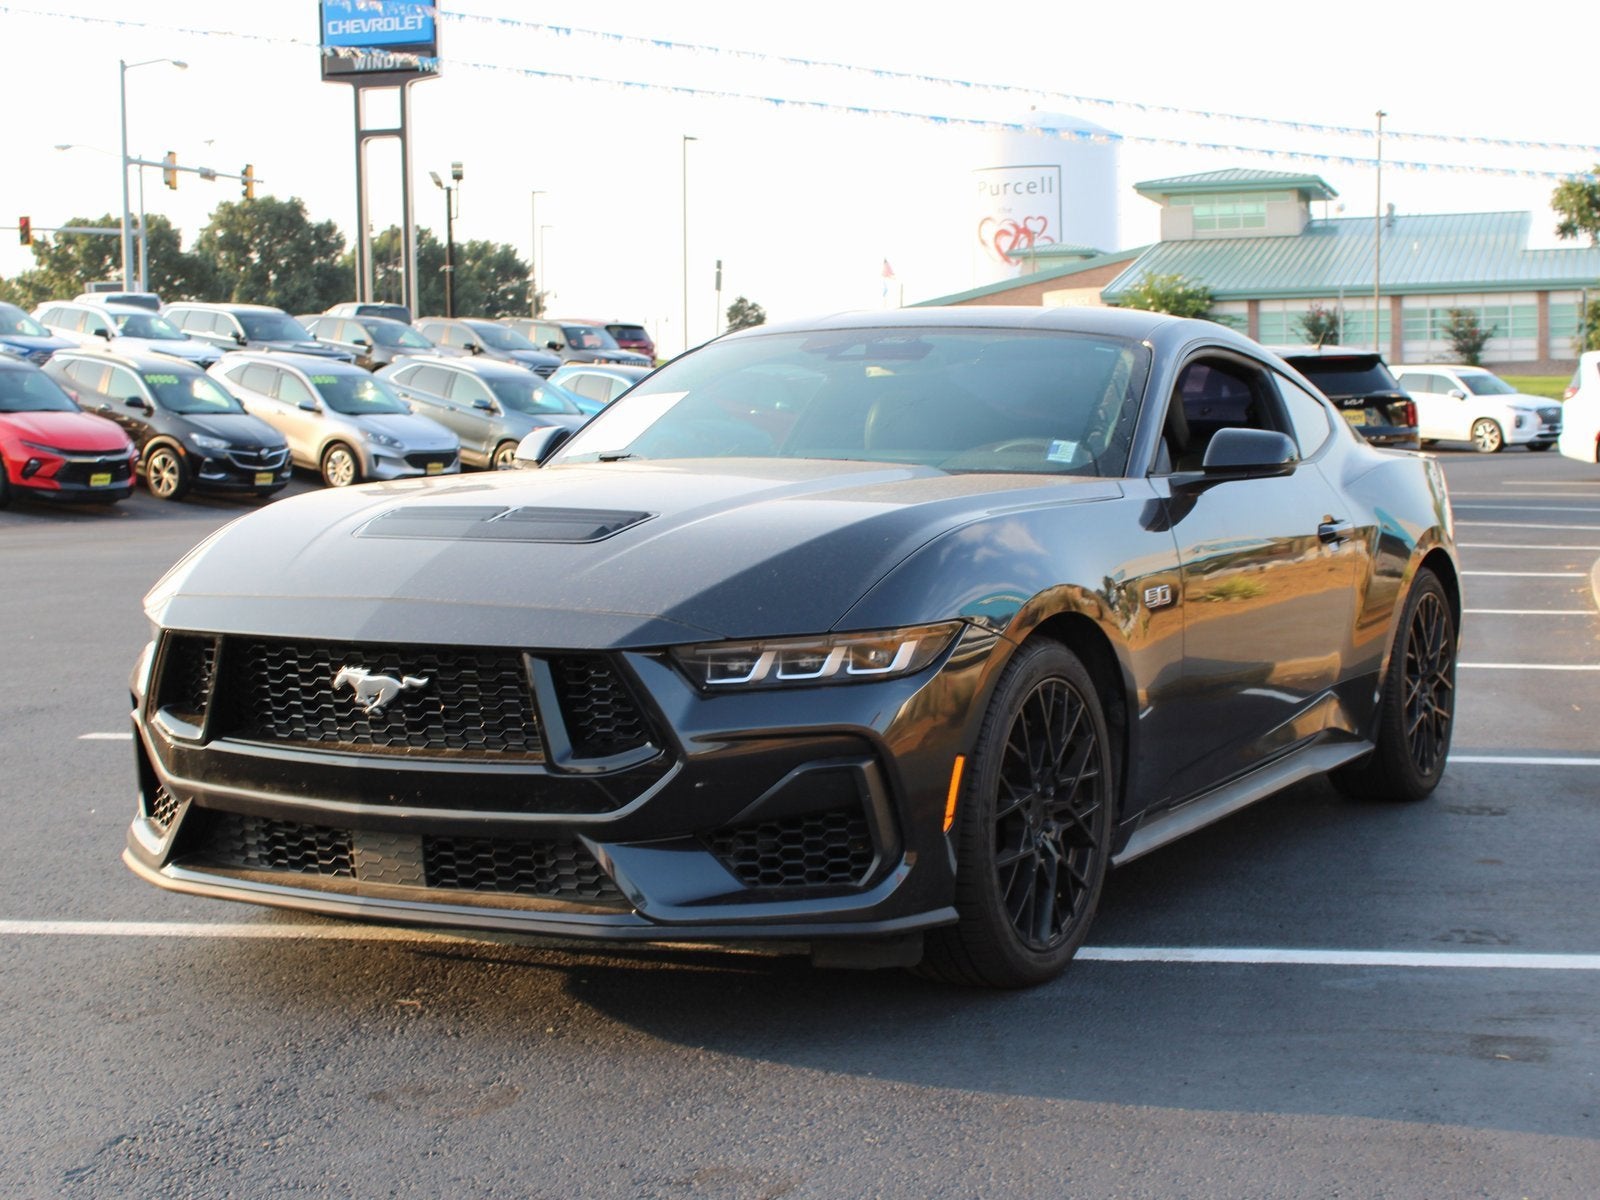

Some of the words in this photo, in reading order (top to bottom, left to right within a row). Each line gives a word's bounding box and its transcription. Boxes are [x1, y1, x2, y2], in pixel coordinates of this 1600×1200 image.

[327, 16, 425, 35] CHEVROLET
[353, 54, 402, 70] WINDY
[978, 176, 1053, 197] Purcell
